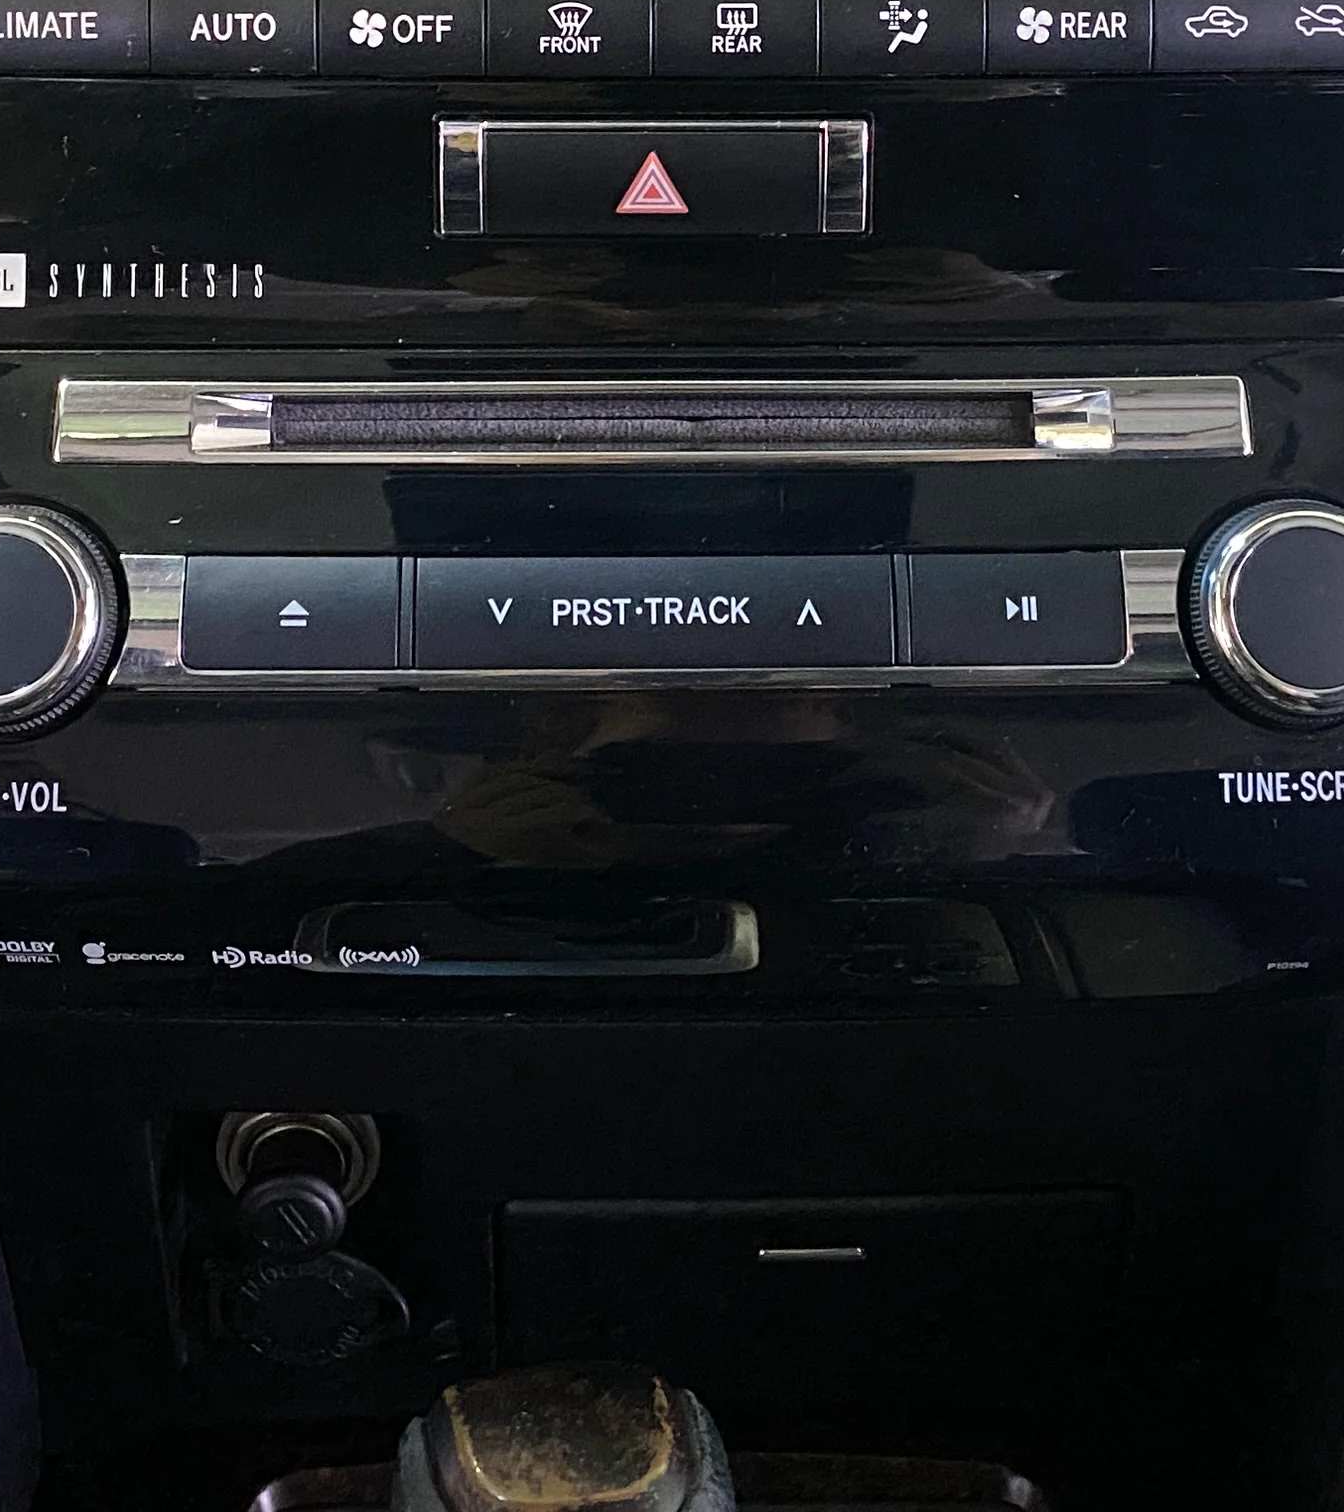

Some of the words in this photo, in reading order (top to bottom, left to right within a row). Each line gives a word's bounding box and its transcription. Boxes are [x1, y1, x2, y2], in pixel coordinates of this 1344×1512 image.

[190, 12, 277, 42] AUTO
[392, 14, 454, 43] OFF
[1060, 11, 1127, 39] REAR
[539, 36, 601, 54] FRONT
[711, 35, 762, 53] REAR
[49, 263, 263, 298] SYNTHESIS
[6, 954, 54, 963] DIGITAL
[106, 951, 185, 963] gracenote
[248, 949, 313, 965] Radio
